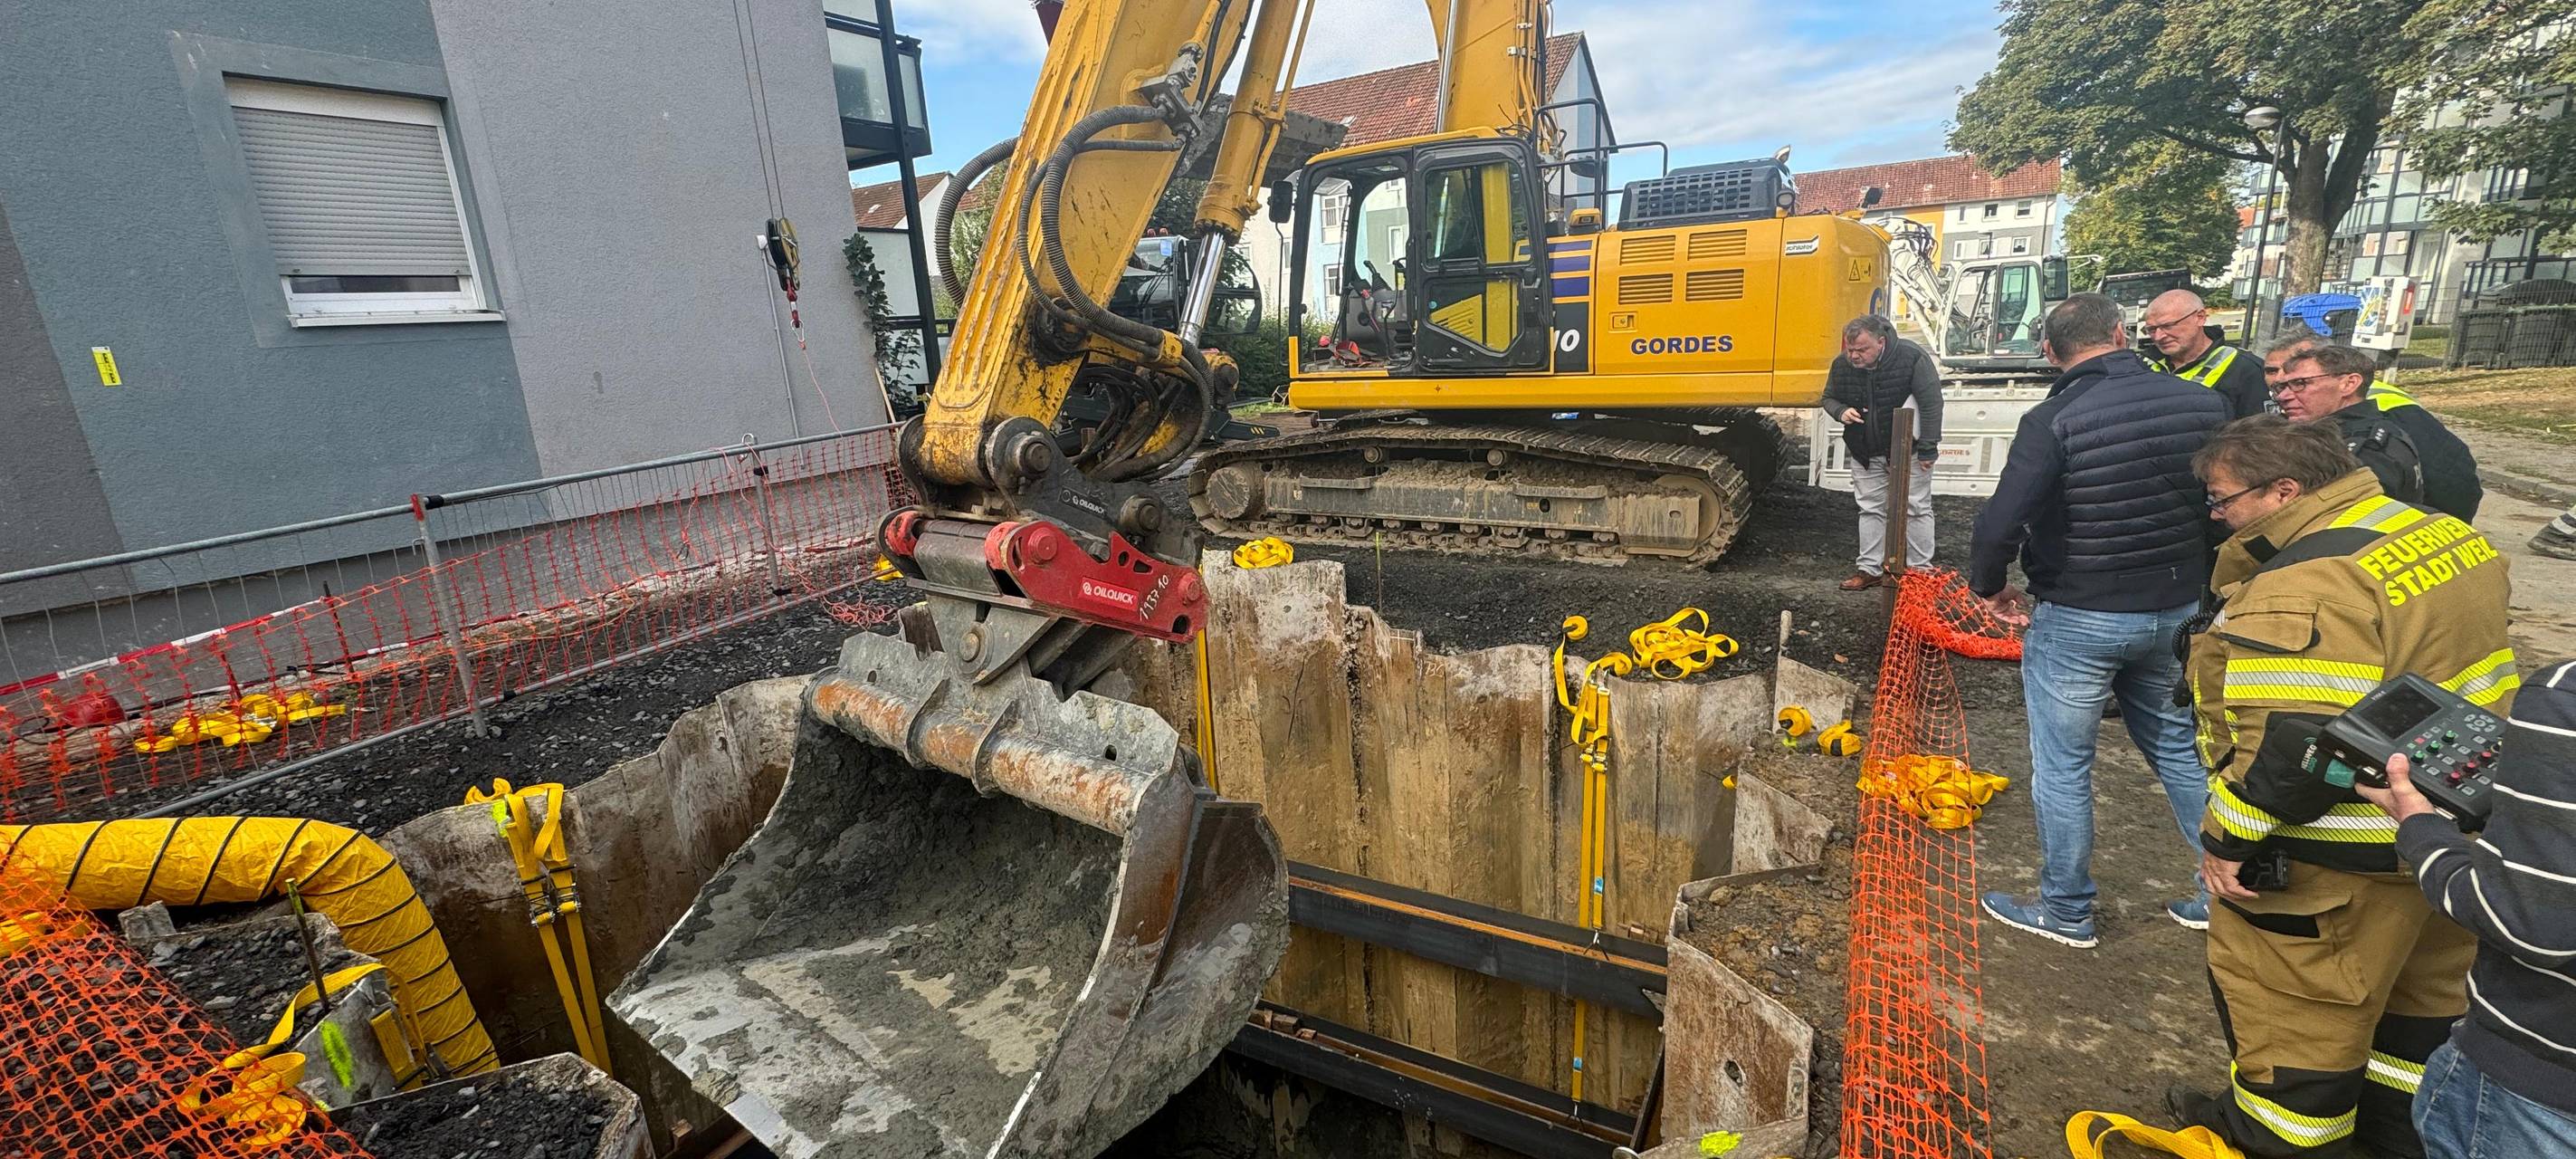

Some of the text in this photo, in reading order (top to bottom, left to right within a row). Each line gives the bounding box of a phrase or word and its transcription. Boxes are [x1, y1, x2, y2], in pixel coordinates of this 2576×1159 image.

[1630, 335, 1733, 355] GORDES
[2385, 551, 2461, 607] STADT
[1093, 586, 1134, 605] OILQUICK
